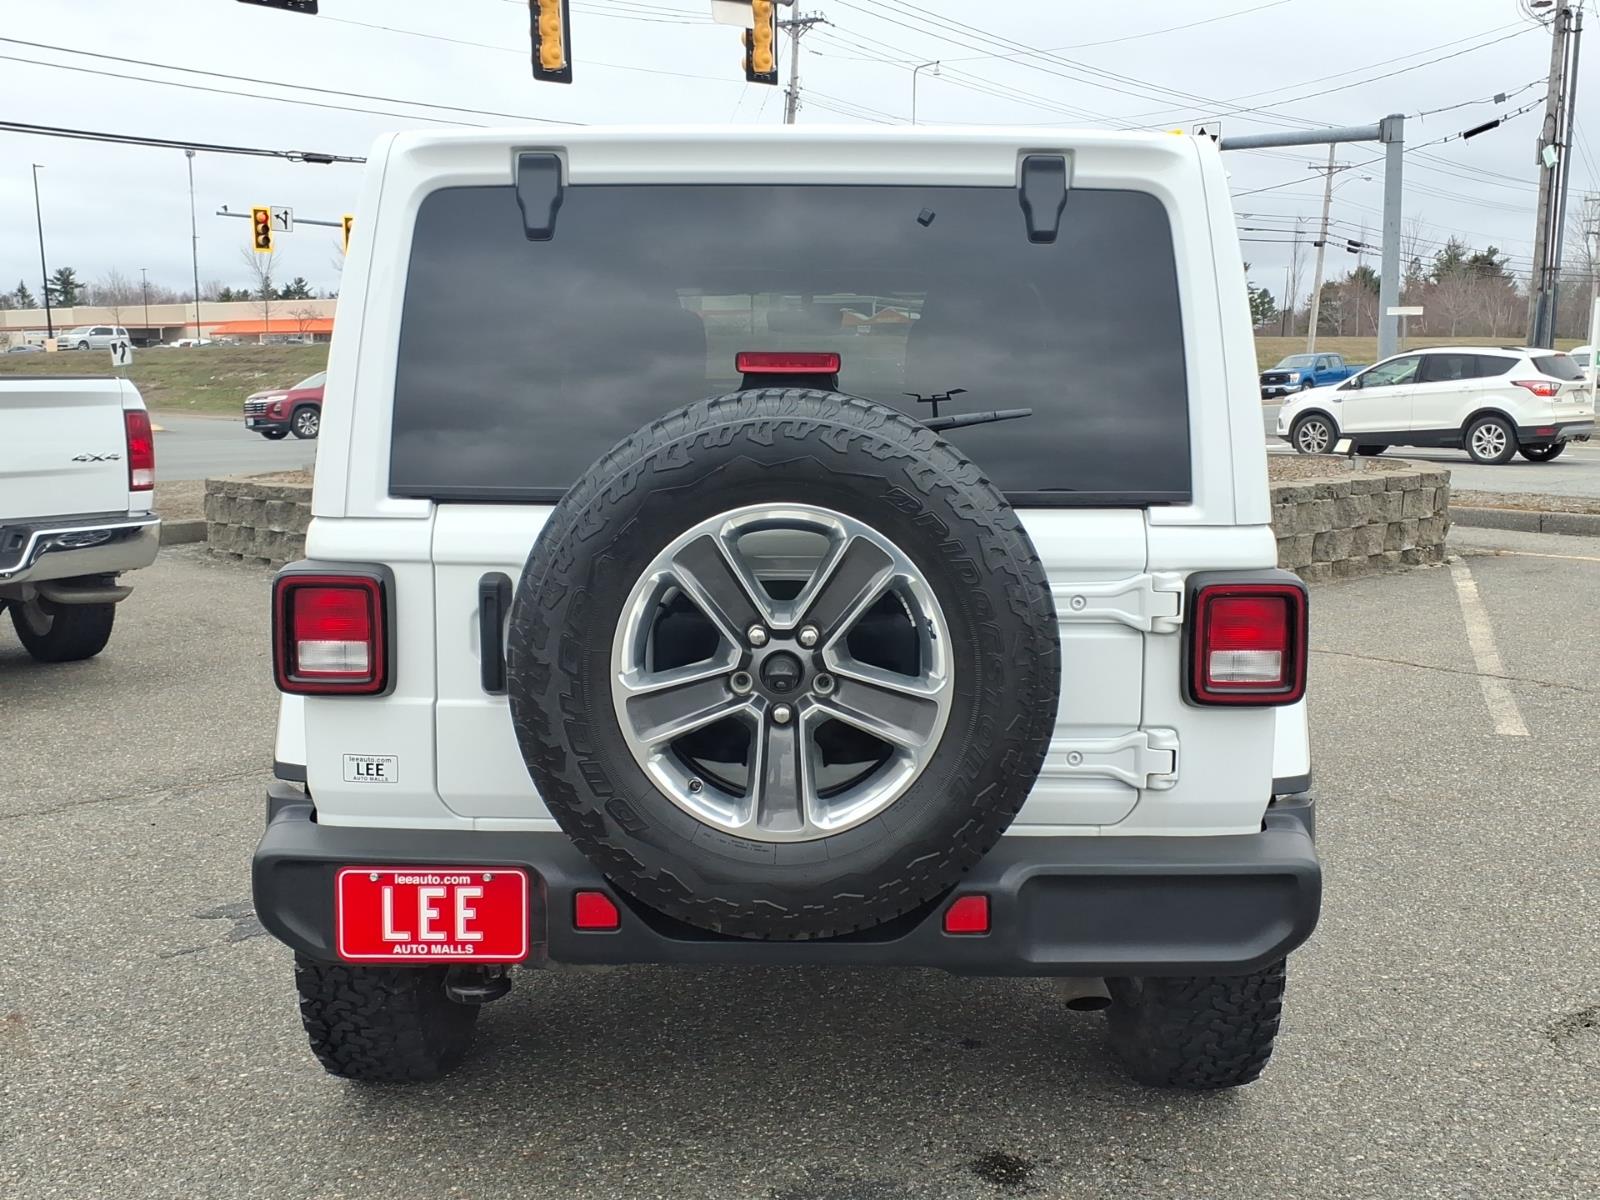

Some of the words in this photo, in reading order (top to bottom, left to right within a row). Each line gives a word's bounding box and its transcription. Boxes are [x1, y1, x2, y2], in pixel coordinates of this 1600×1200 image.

[357, 762, 384, 776] LEE
[394, 874, 471, 885] leeauto.com
[382, 886, 483, 941] LEE
[393, 944, 428, 954] AUTO
[431, 944, 474, 954] MALLS
